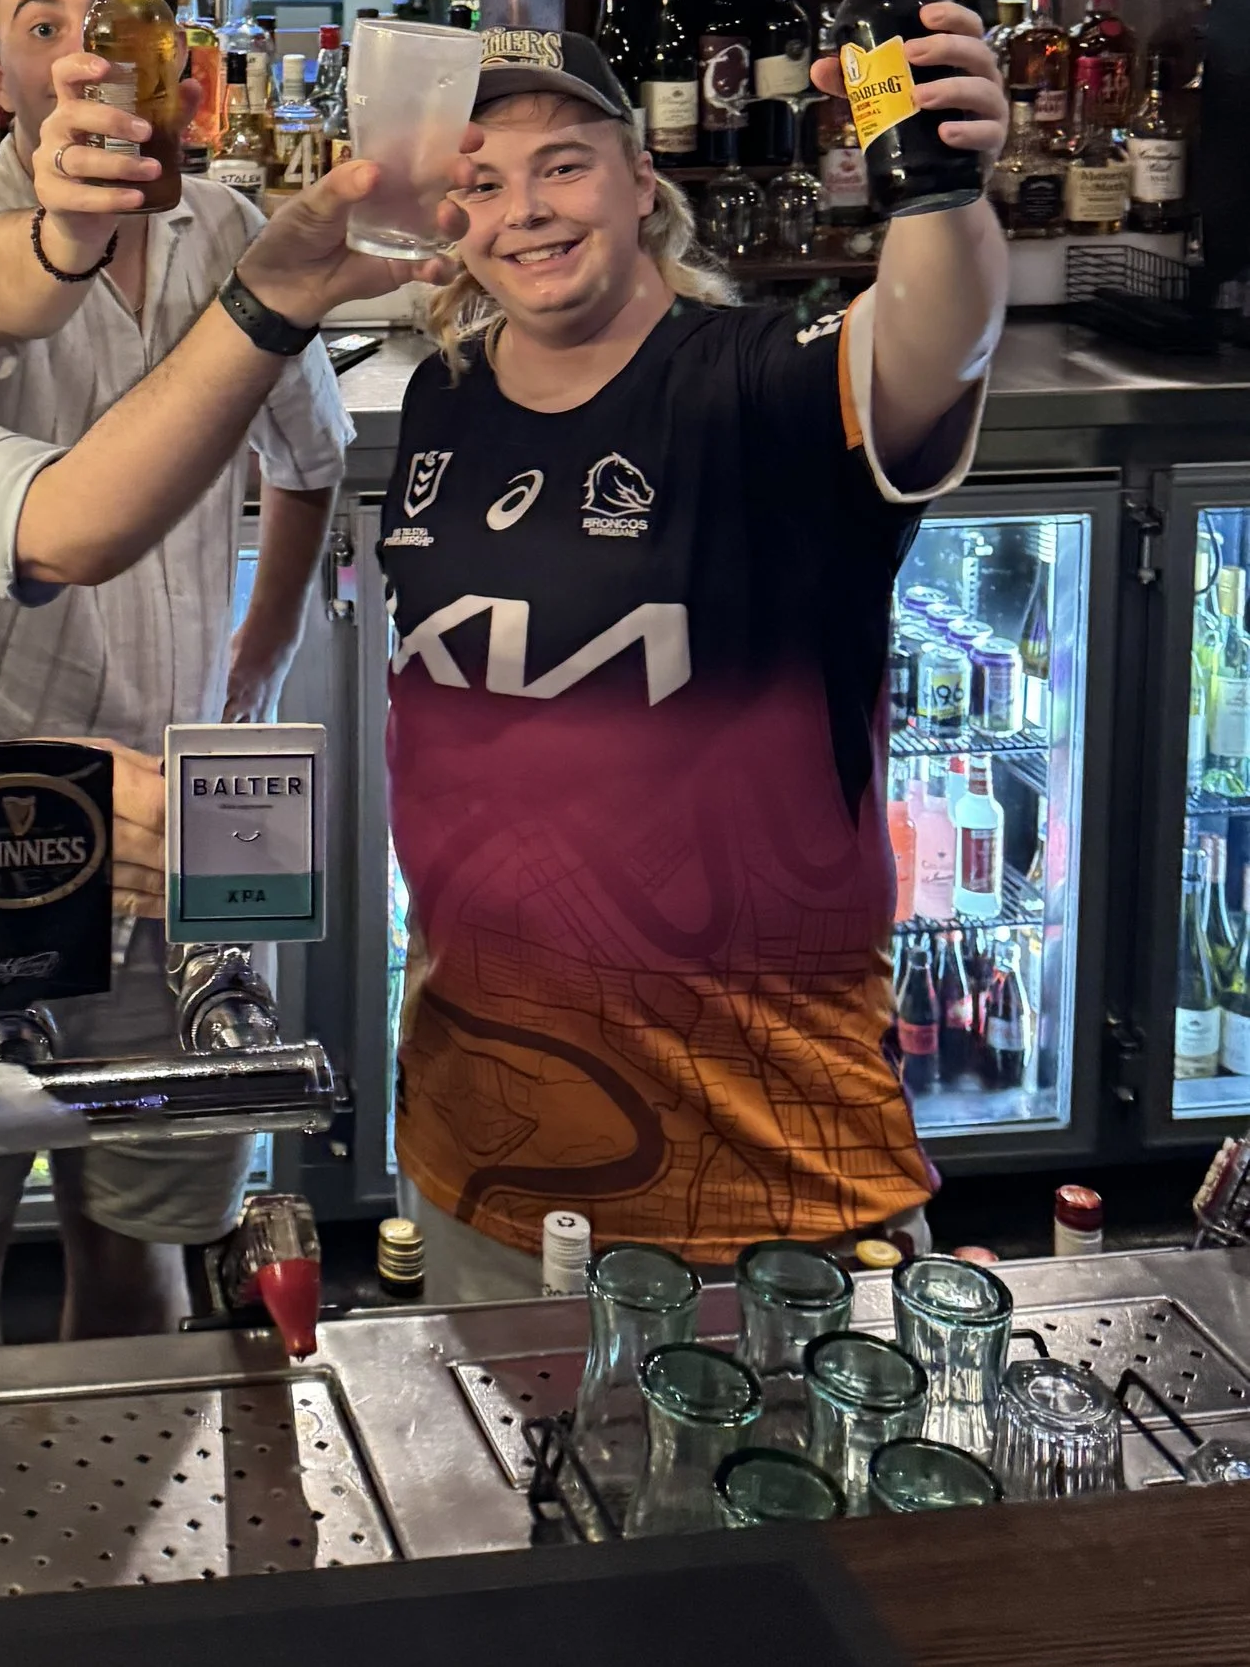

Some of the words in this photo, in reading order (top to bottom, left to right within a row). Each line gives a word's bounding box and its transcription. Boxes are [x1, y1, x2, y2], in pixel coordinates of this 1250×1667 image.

[582, 517, 648, 530] BRONCOS
[192, 776, 302, 797] BALTER
[227, 890, 267, 903] XPA
